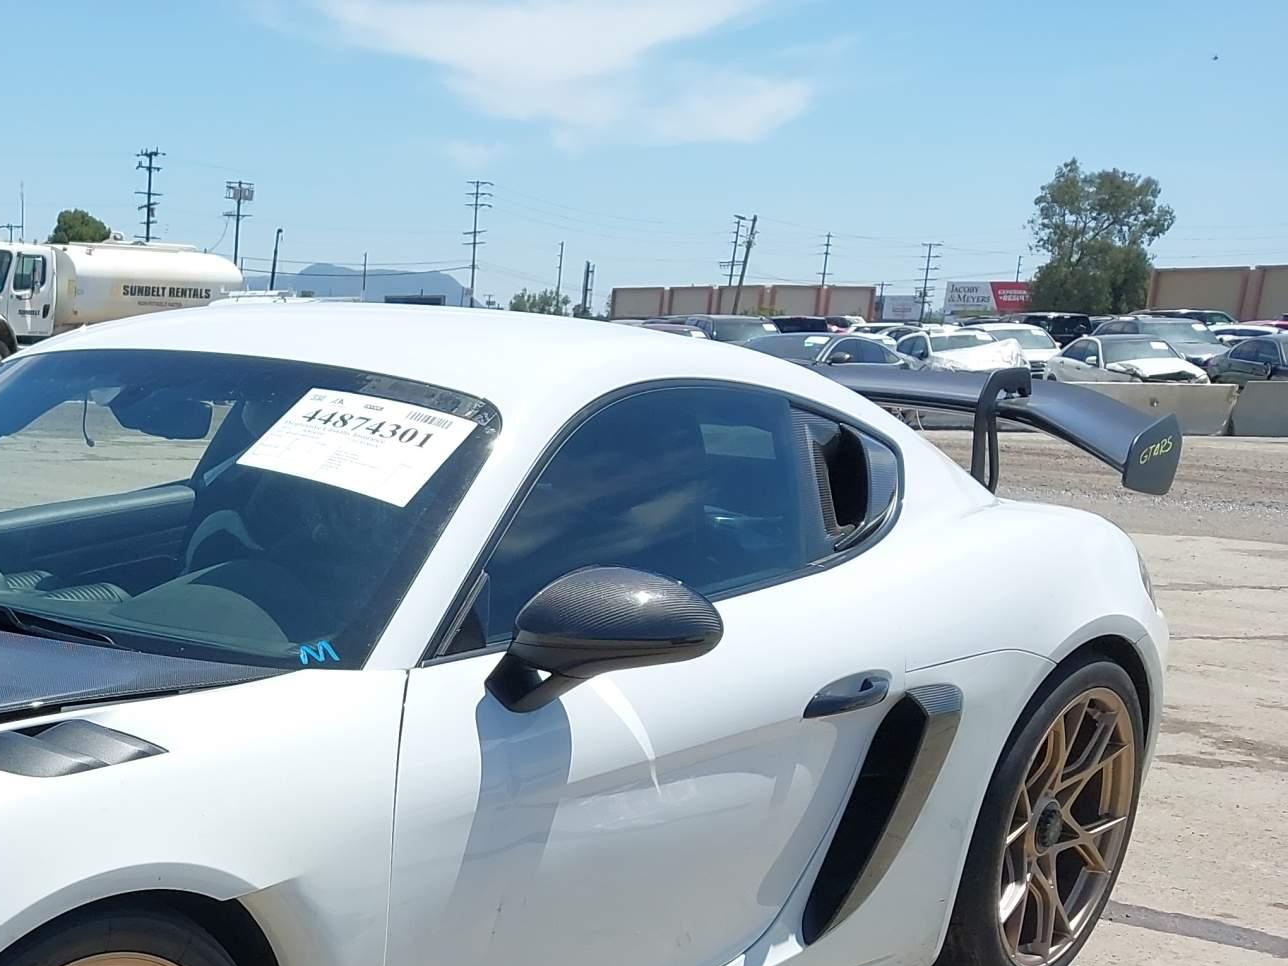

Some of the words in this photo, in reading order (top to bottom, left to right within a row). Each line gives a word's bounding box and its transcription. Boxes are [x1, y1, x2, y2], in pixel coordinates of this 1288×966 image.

[122, 285, 167, 297] SUNBELT
[168, 286, 212, 299] RENTALS
[302, 408, 434, 448] 44874301
